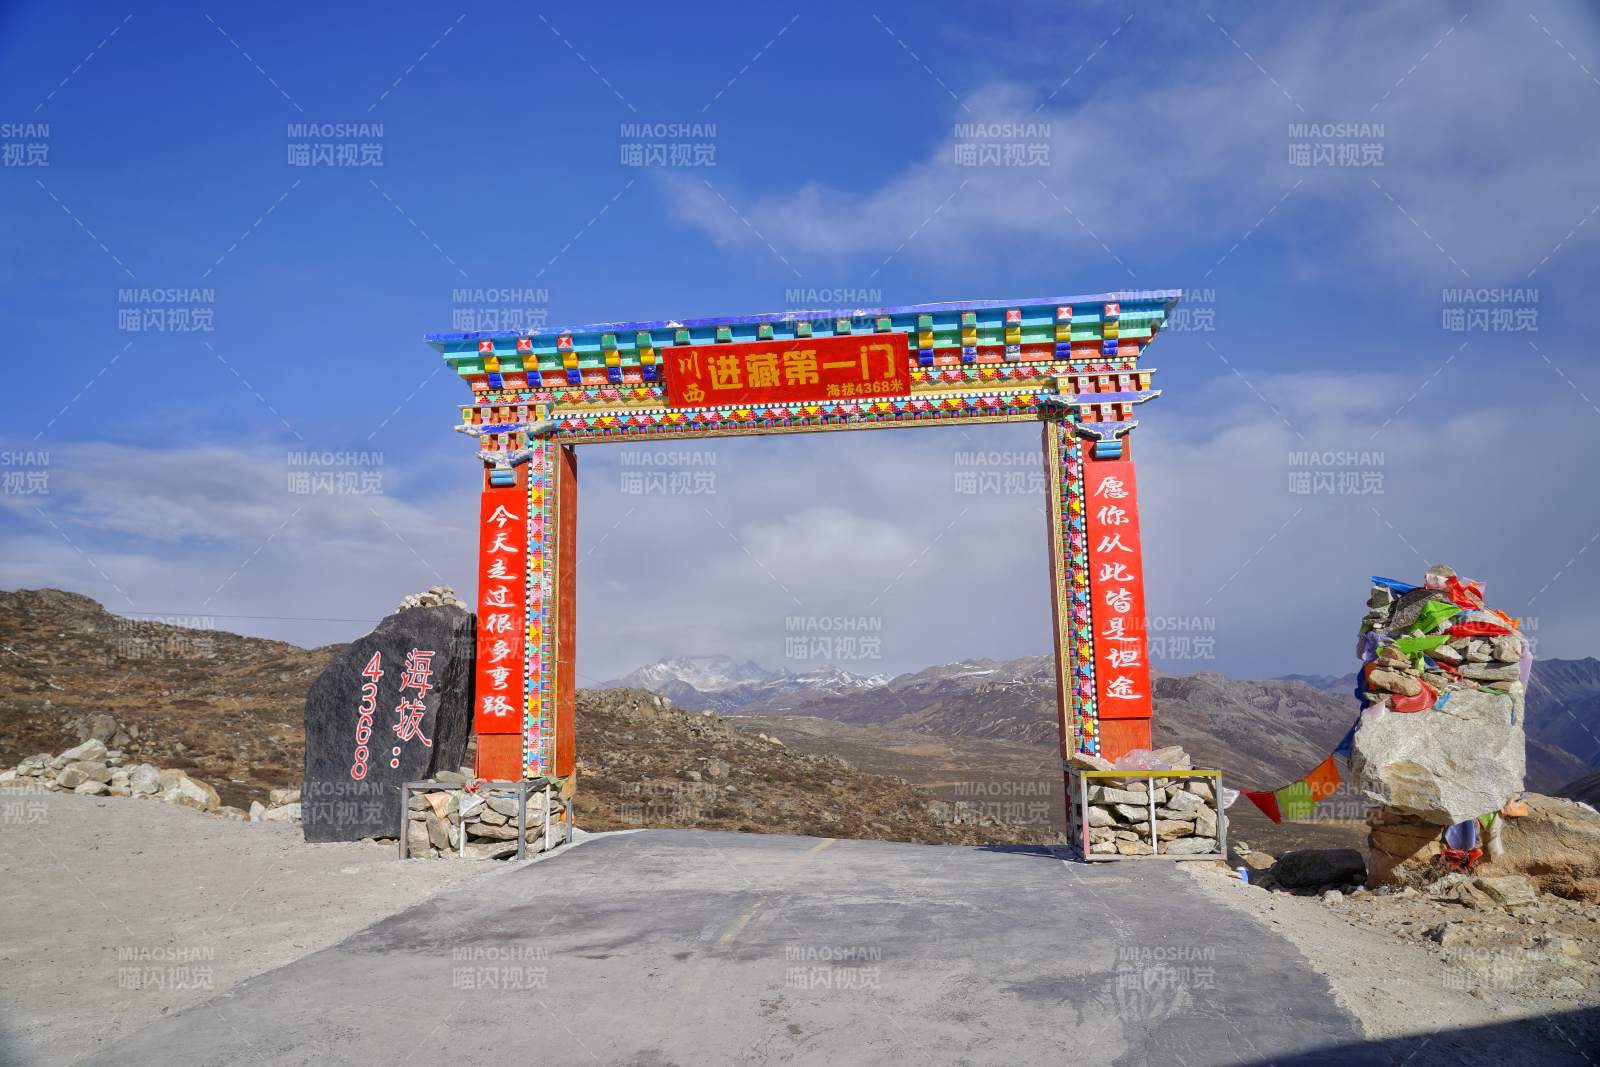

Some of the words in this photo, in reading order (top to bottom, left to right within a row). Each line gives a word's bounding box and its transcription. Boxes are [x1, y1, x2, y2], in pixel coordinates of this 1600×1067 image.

[678, 351, 705, 402] 川西
[707, 343, 896, 390] 进藏第一门
[826, 379, 904, 397] 海拔4368米
[482, 504, 520, 717] 今天走过很多弯路
[1094, 475, 1143, 700] 愿你从此皆是坦途
[351, 651, 384, 780] 4368
